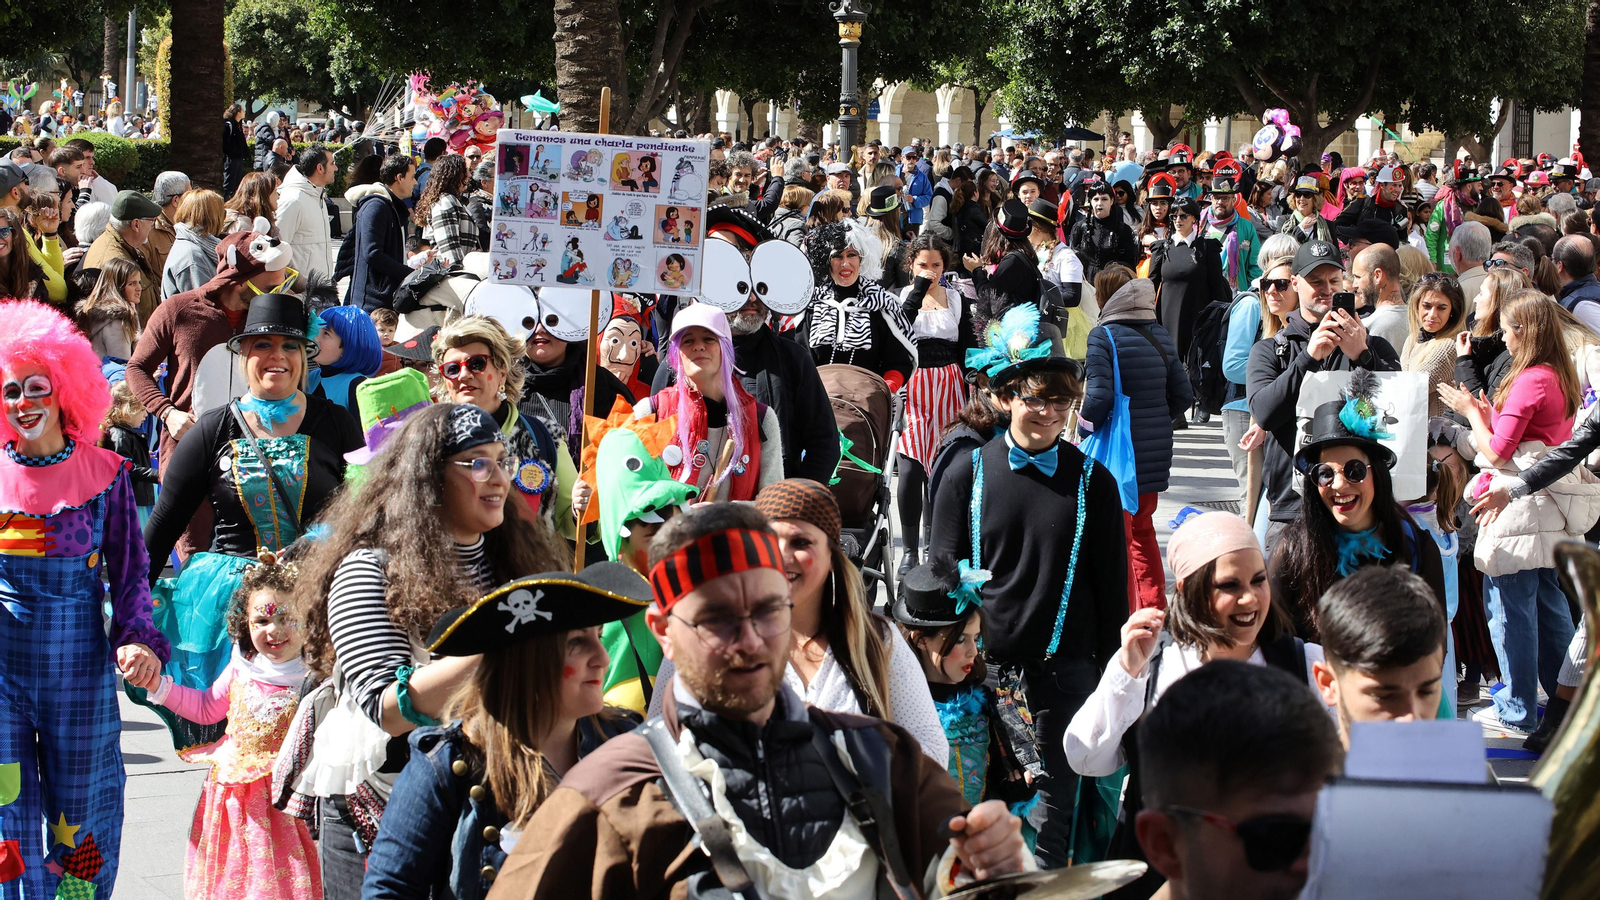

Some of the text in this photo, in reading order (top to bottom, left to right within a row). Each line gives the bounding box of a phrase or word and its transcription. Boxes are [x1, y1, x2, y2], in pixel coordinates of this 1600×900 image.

[514, 132, 566, 144] Tenemos
[594, 138, 632, 148] charla
[636, 142, 695, 153] pendiente
